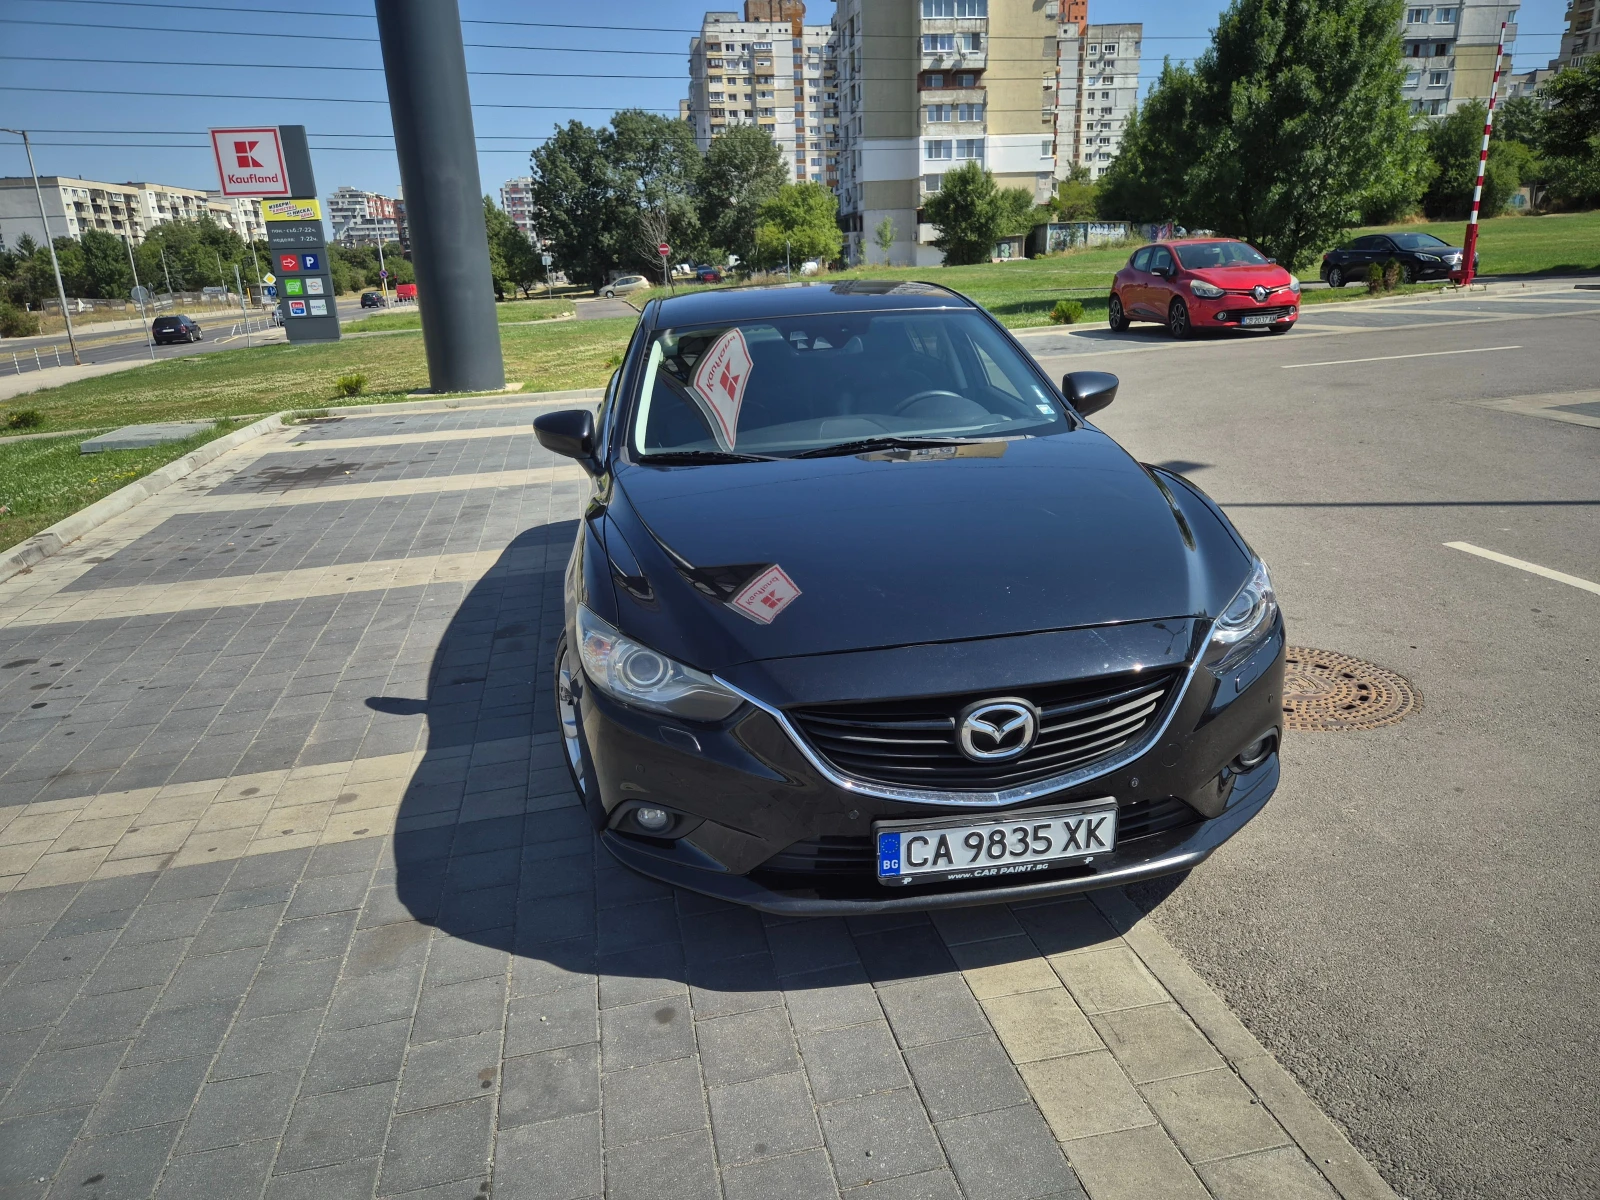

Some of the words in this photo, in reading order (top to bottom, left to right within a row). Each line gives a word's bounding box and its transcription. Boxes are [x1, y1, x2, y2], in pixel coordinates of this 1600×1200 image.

[227, 173, 279, 184] Kaufland
[305, 256, 315, 268] P
[906, 833, 954, 868] CA
[963, 823, 1053, 863] 9835
[1062, 816, 1108, 852] XK
[882, 859, 899, 870] BG
